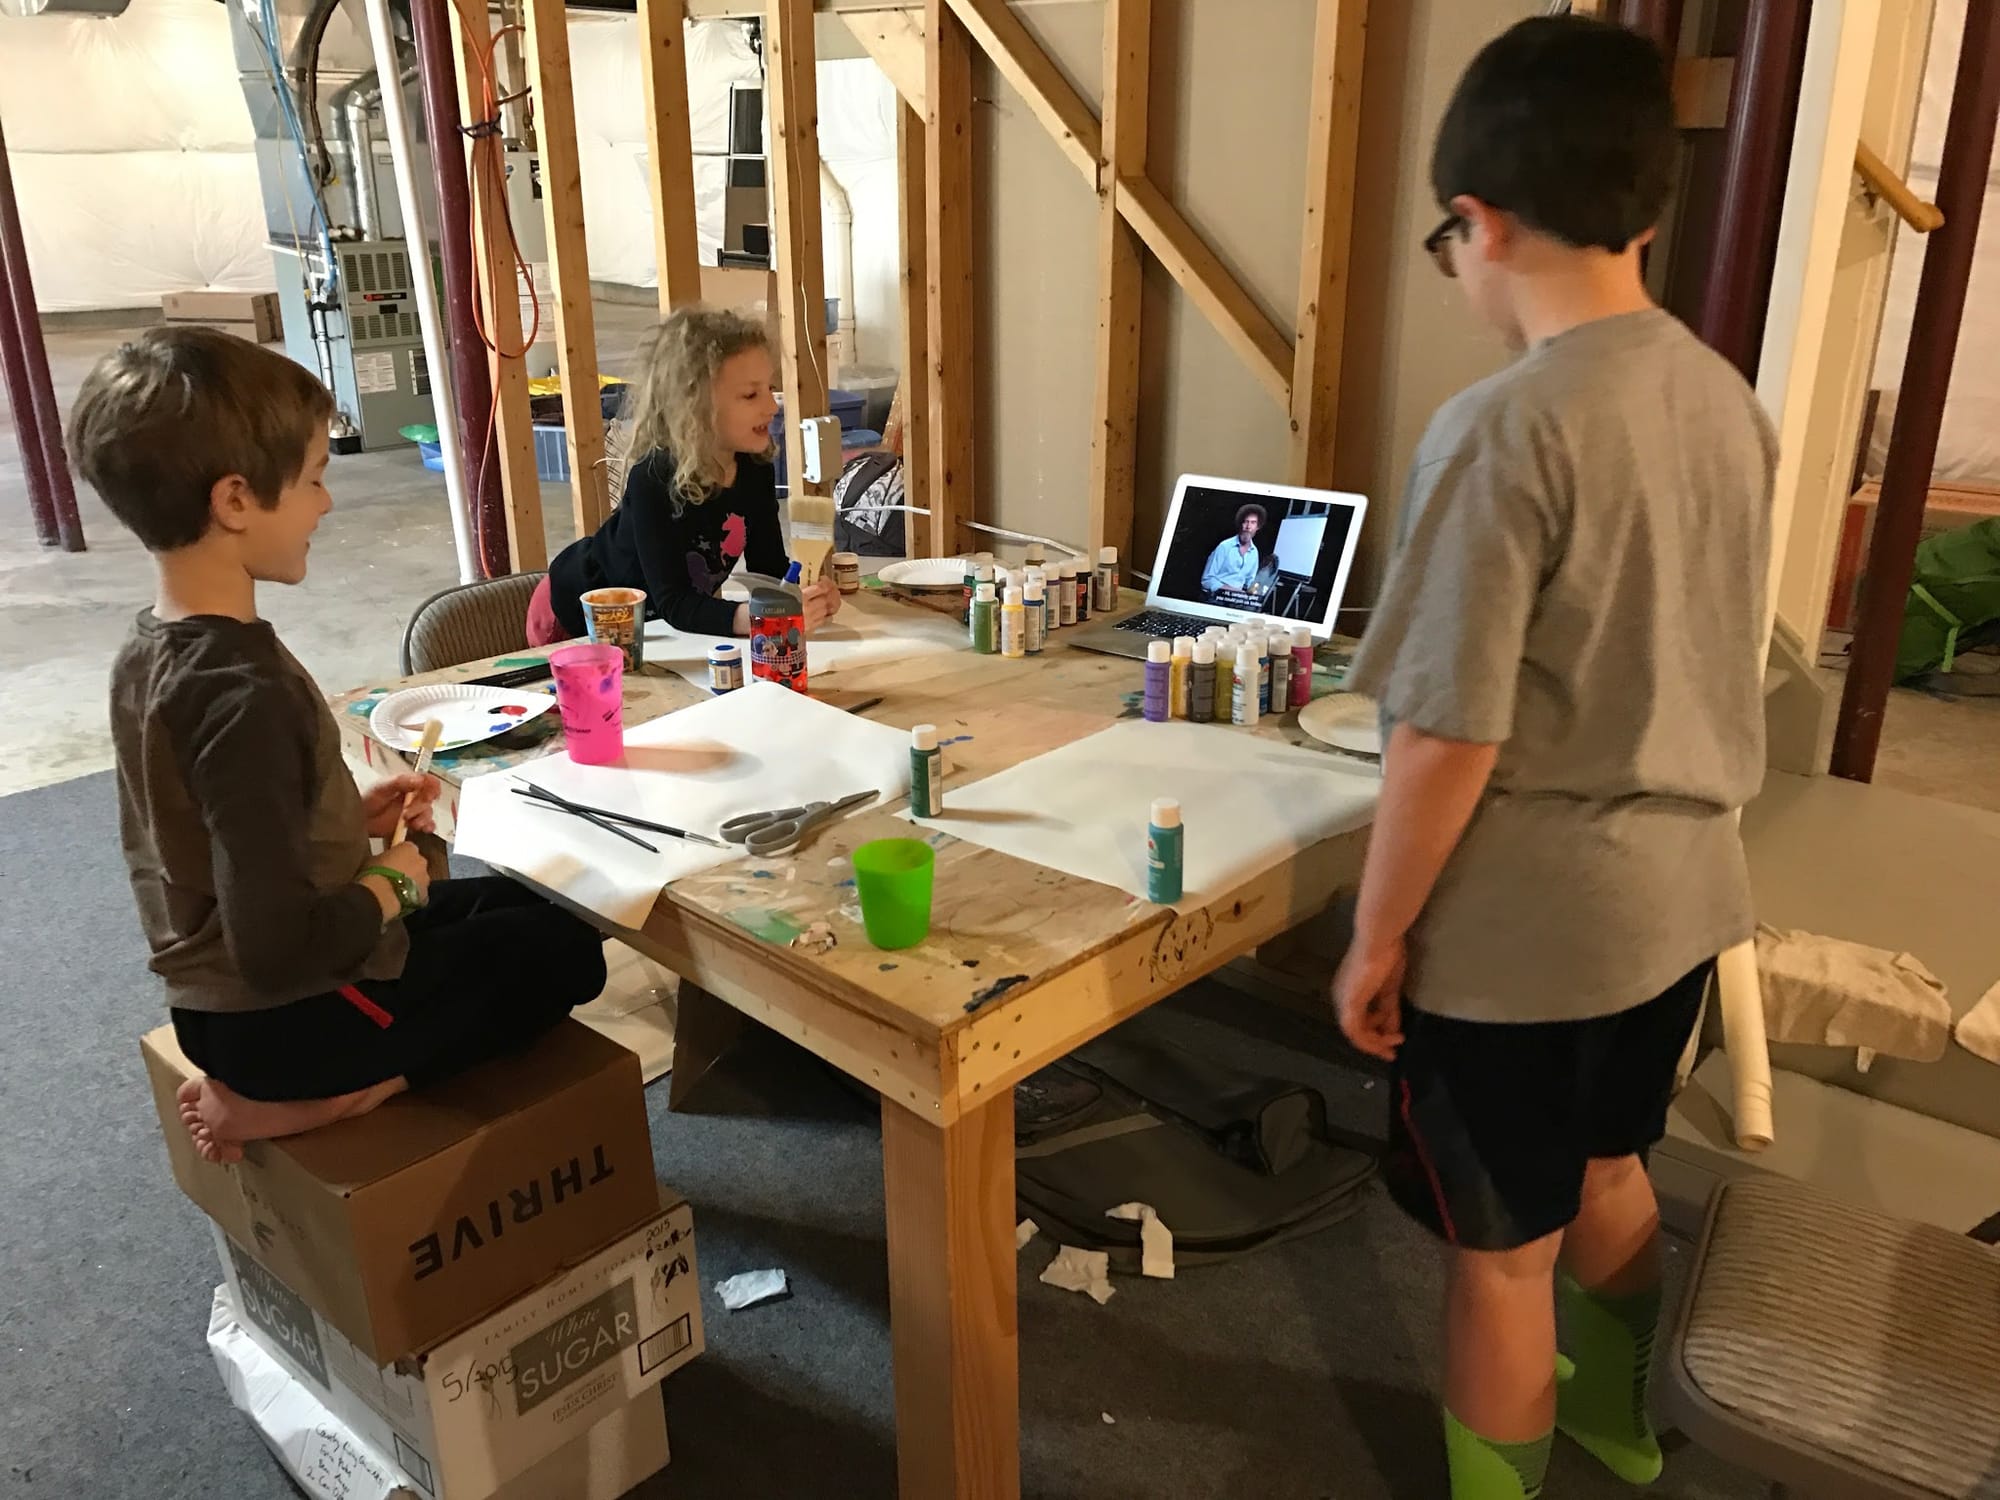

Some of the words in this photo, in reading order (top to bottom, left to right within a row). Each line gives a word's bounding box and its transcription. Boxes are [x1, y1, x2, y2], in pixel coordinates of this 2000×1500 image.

[408, 1144, 615, 1281] THRIVE
[646, 1218, 671, 1241] 2015
[240, 1277, 323, 1373] SUGAR
[484, 1310, 538, 1346] FAMILY
[546, 1281, 586, 1310] HOME
[546, 1308, 601, 1347] White
[521, 1311, 634, 1399] SUGAR
[580, 1372, 619, 1401] CHRIST
